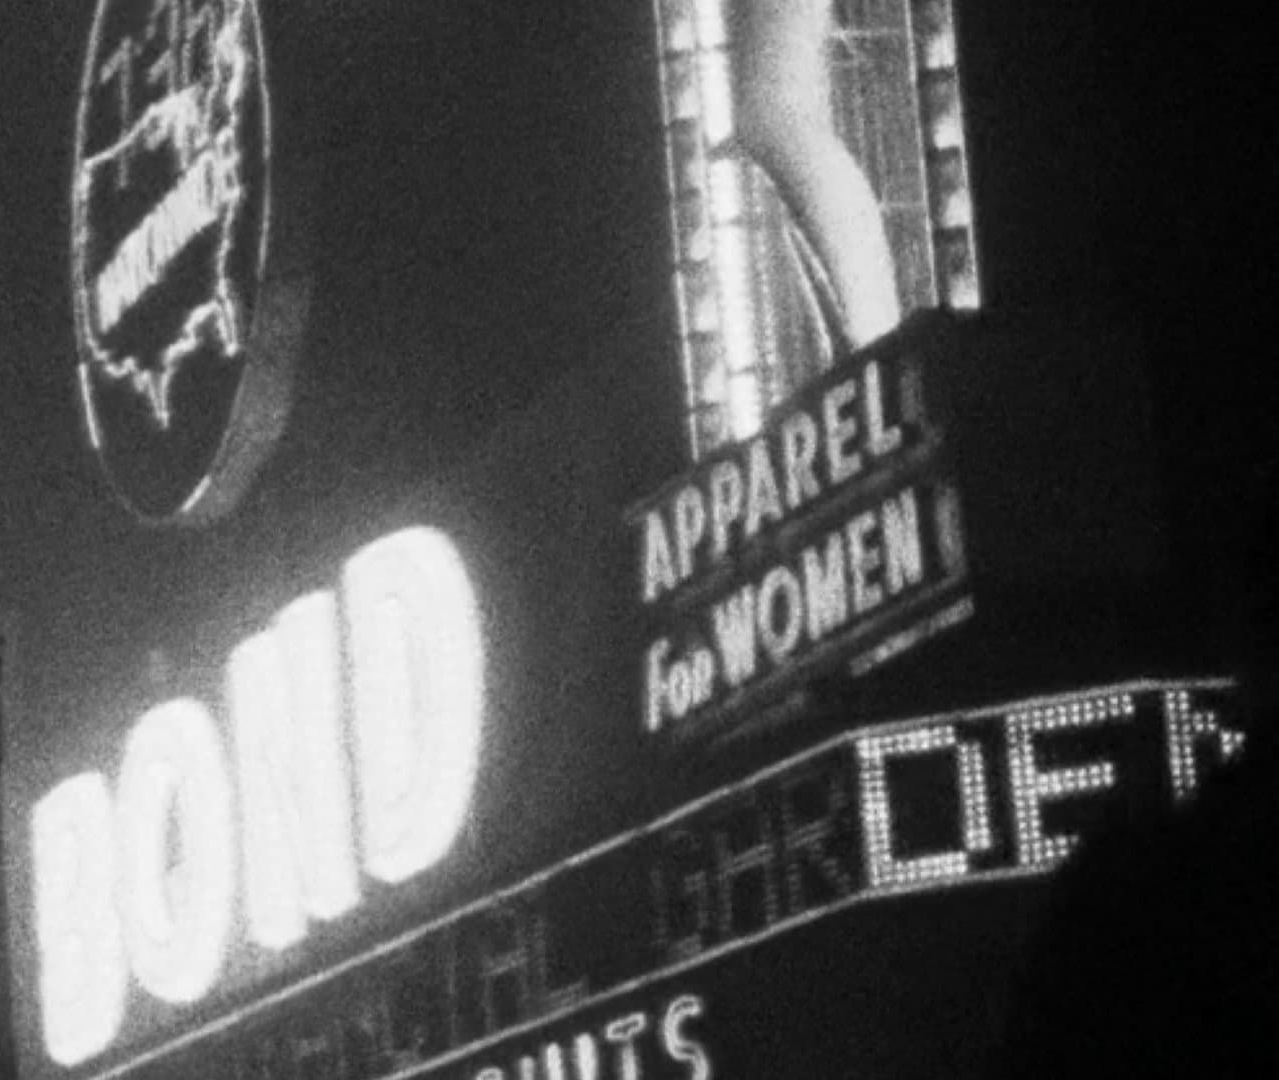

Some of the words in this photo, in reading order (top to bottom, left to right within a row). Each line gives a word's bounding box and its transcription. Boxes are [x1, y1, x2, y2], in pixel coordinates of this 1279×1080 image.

[643, 360, 902, 602] APPAREL
[712, 486, 925, 688] WOMEN
[31, 524, 483, 1069] BOND
